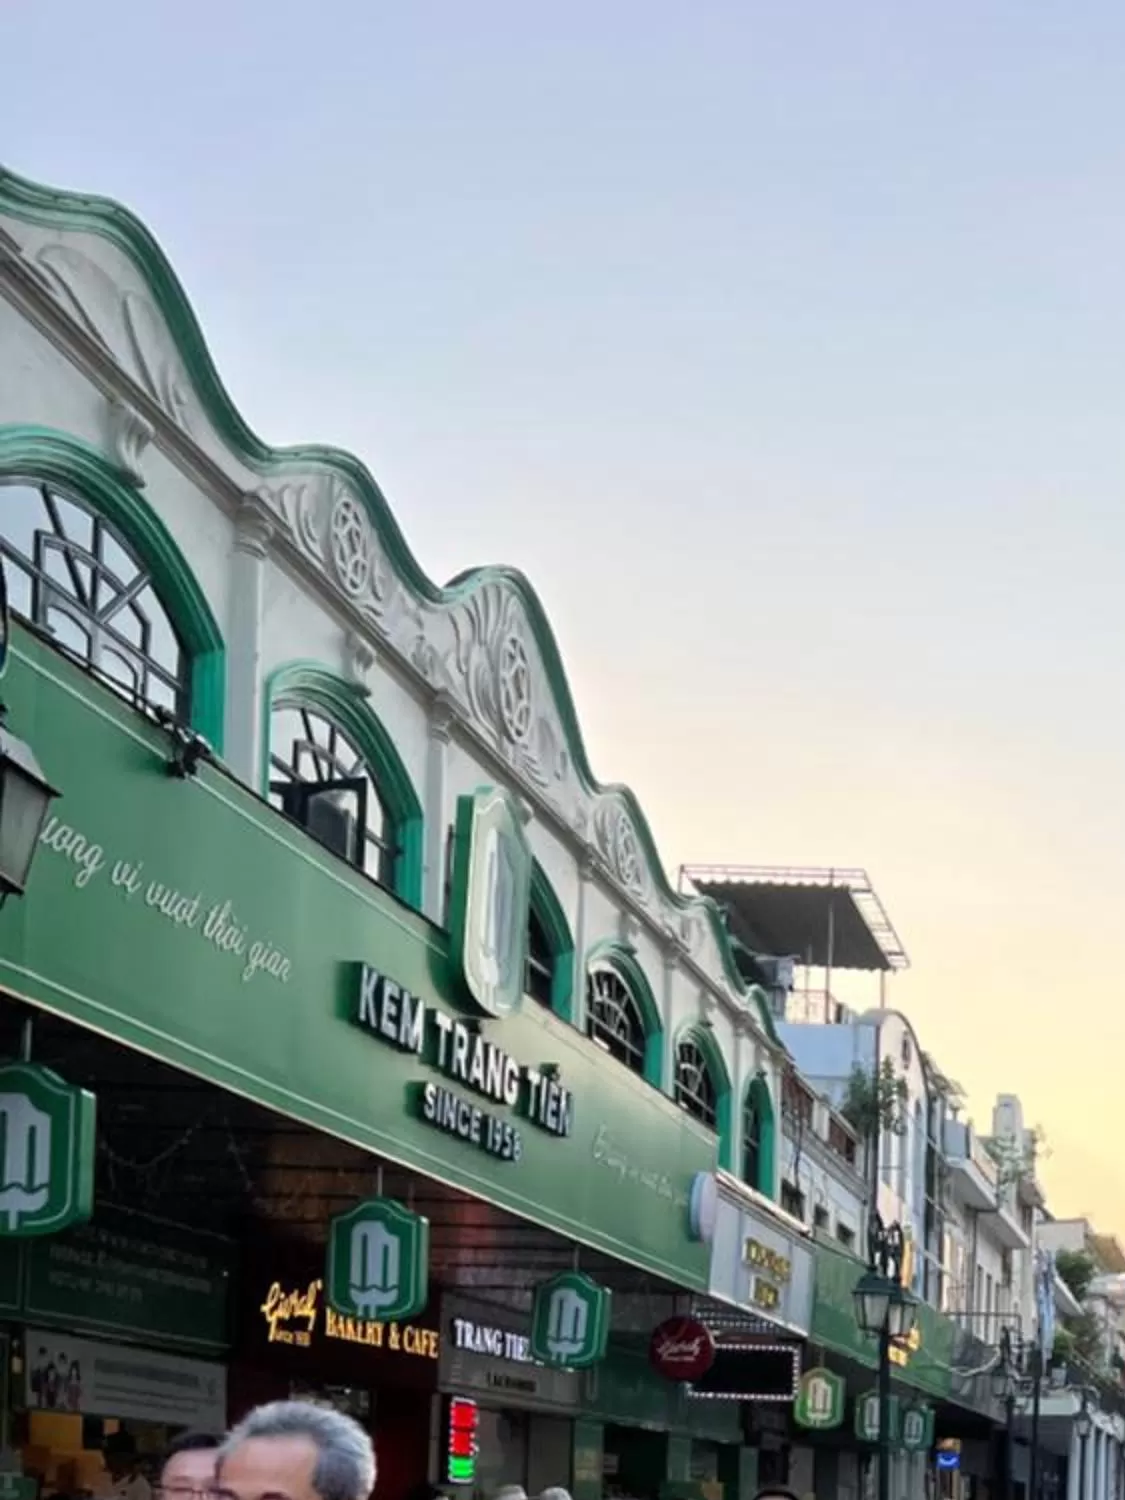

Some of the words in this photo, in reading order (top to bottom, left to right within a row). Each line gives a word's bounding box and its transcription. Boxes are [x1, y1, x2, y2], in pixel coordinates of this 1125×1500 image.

[243, 940, 291, 982] gian
[359, 964, 424, 1053] KEM
[424, 1083, 482, 1141] SINCE
[389, 1321, 400, 1350] &
